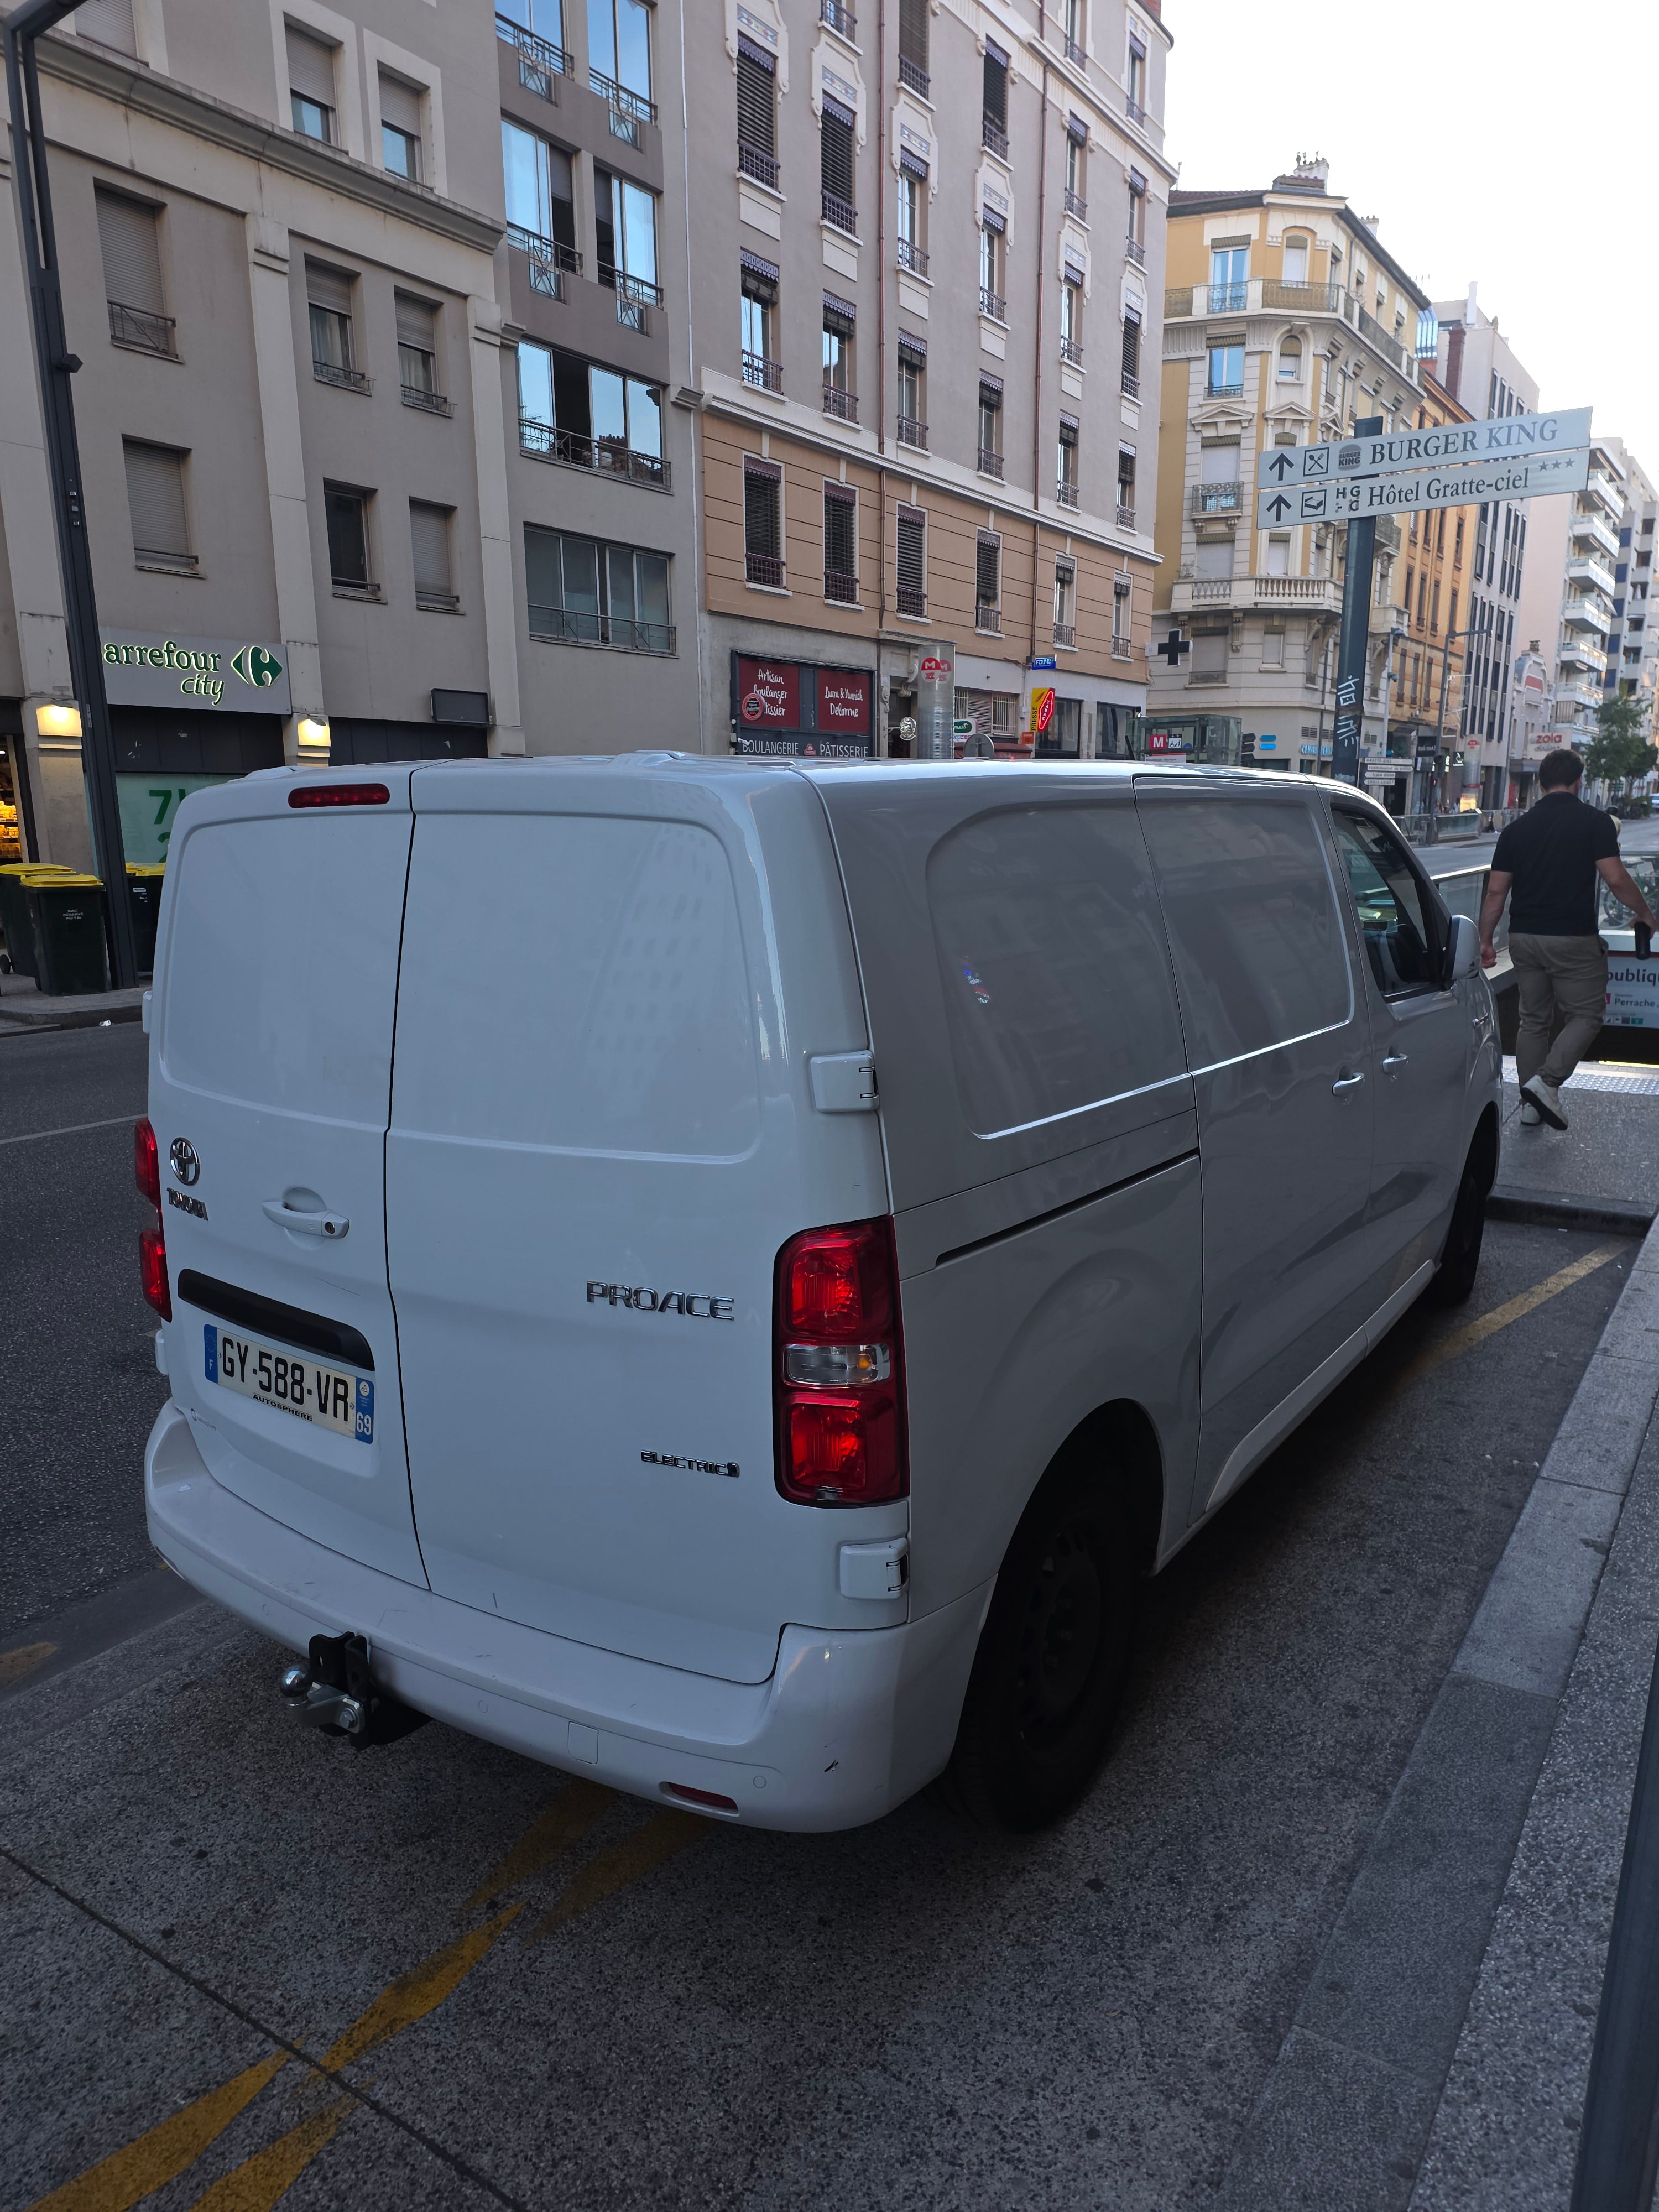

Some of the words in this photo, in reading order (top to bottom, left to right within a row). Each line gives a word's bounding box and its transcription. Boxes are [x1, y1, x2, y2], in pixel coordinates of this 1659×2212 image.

[1369, 430, 1478, 465] BURGER
[1485, 419, 1558, 449] KING
[1338, 451, 1361, 459] BURGER
[1338, 457, 1361, 467] KING
[1368, 481, 1420, 507] Hôtel
[1426, 467, 1529, 499] Gratte-ciel
[101, 640, 222, 672] arrefour
[925, 661, 936, 669] M
[758, 669, 784, 685] Artisan
[180, 673, 225, 706] city
[753, 684, 788, 705] boulanger
[825, 686, 839, 699] Laura
[840, 687, 844, 699] &
[844, 688, 863, 701] Yannick
[764, 702, 786, 716] tissier
[1042, 700, 1050, 721] TABAC
[743, 739, 799, 755] BOULANGERIE
[1153, 737, 1164, 748] M
[1536, 732, 1562, 744] zola
[820, 741, 869, 758] PÂTISSERIE
[1614, 997, 1655, 1007] Perrache
[166, 1187, 209, 1222] TOYOTA
[586, 1280, 734, 1321] PROACE
[209, 1359, 214, 1370] F
[356, 1411, 372, 1436] 69
[253, 1394, 314, 1422] AUTOSPHERE
[641, 1449, 728, 1477] ELECTRIC
